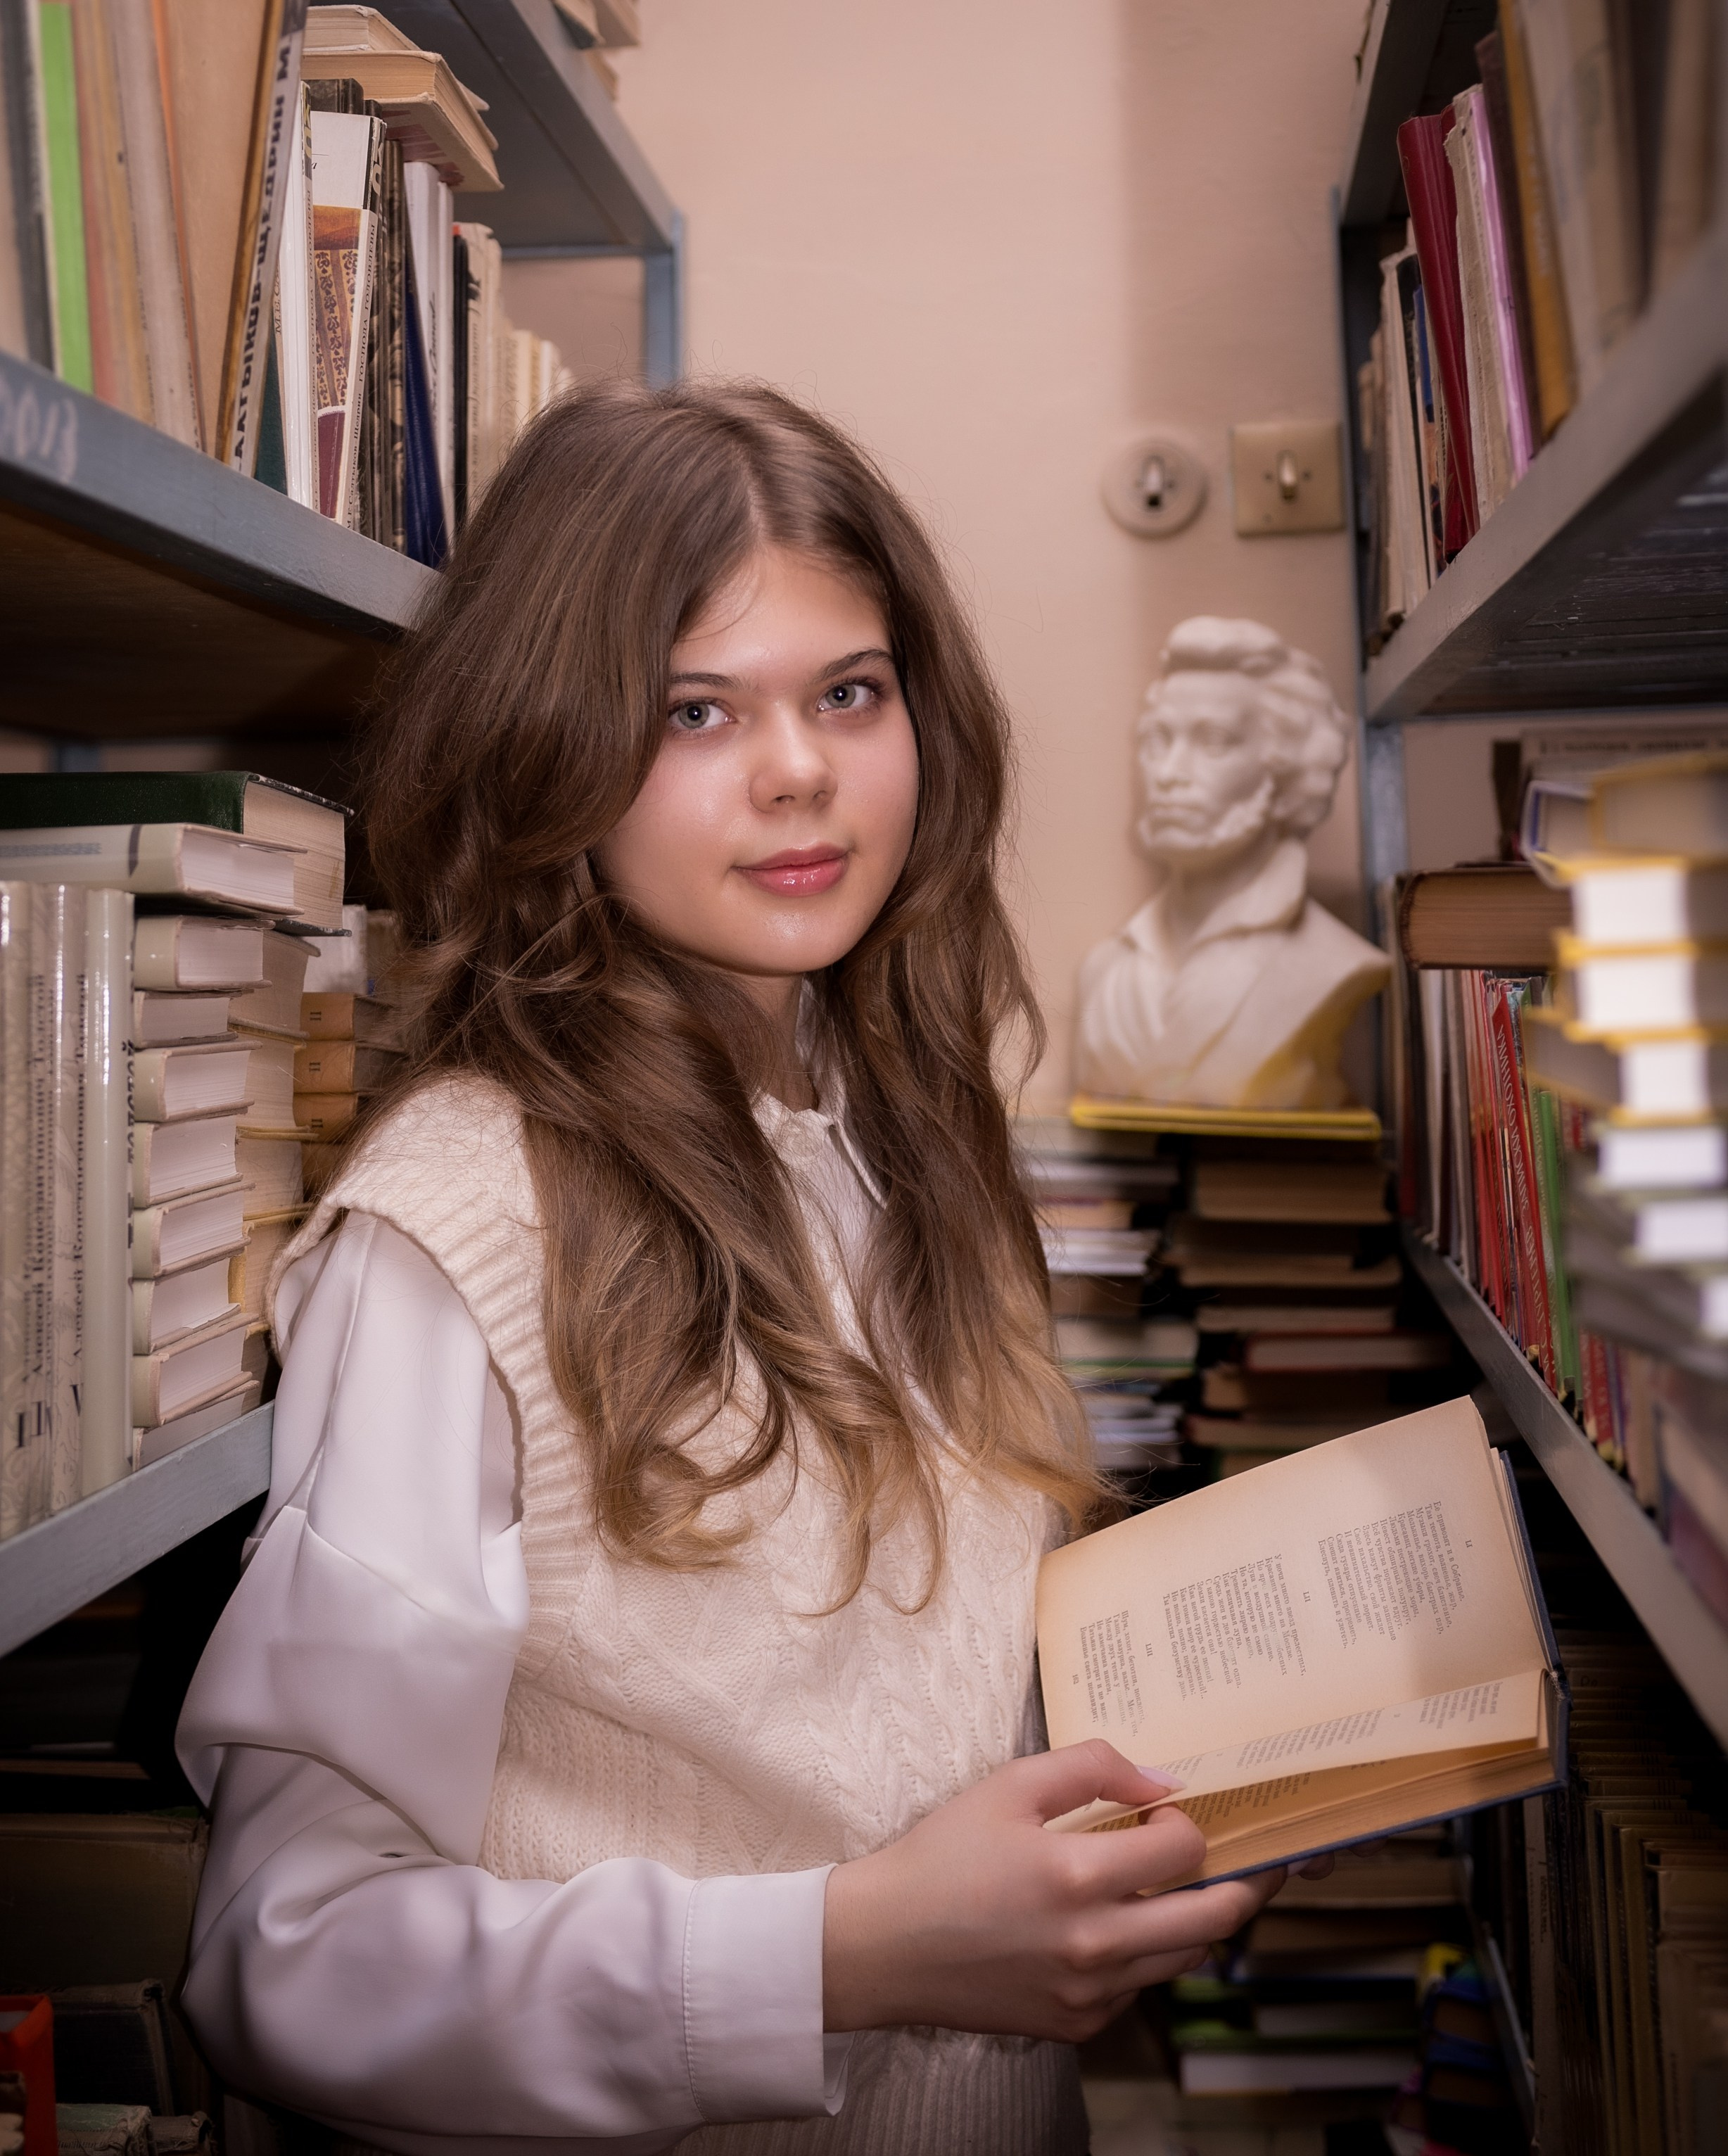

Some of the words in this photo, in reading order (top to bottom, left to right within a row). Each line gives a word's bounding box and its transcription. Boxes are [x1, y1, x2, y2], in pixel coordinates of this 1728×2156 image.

[235, 94, 284, 471] АЛТЫКОВ-ЩЕДРИН
[359, 319, 368, 382] ГОСПОДА
[364, 224, 375, 310] ГОЛОВЛЕВЫ
[1497, 1024, 1516, 1127] ОХОТНИКА
[1511, 1126, 1530, 1212] ЗАПИСКИ
[1525, 1225, 1544, 1324] ТУРГЕНЕВ
[1423, 1503, 1435, 1520] Там
[1432, 1500, 1442, 1512] Ее
[1344, 1529, 1353, 1538] И
[1360, 1523, 1374, 1547] Здесь
[1370, 1521, 1381, 1537] Всё
[1379, 1518, 1393, 1545] Невест
[1395, 1511, 1413, 1549] Красавиц
[1404, 1509, 1425, 1553] Мельканье,
[1413, 1506, 1430, 1538] Музыки
[1434, 1513, 1451, 1548] привозят
[1333, 1532, 1347, 1554] Сюда
[1352, 1526, 1364, 1546] Свое
[1426, 1521, 1442, 1553] теснота,
[1271, 1553, 1282, 1562] У
[1326, 1535, 1340, 1565] Спешат
[1366, 1547, 1379, 1573] кажут
[1373, 1537, 1387, 1567] чувства
[1406, 1549, 1419, 1575] легкие
[1421, 1538, 1437, 1566] грохот,
[1238, 1565, 1248, 1578] Но
[1263, 1556, 1280, 1593] Красавиц
[1275, 1562, 1285, 1580] ночи
[1338, 1554, 1352, 1582] гусары
[1346, 1538, 1368, 1602] невнимательный
[1356, 1546, 1374, 1591] нахальство,
[1385, 1545, 1404, 1586] обширный
[1386, 1514, 1404, 1547] Людьми
[1395, 1547, 1414, 1594] пестреющие
[1406, 1594, 1421, 1618] хоры,
[1416, 1552, 1430, 1580] вихорь
[1430, 1566, 1442, 1585] свеч
[1435, 1552, 1453, 1591] волненье,
[1187, 1583, 1197, 1599] Как
[1195, 1580, 1207, 1604] Земли
[1205, 1577, 1213, 1585] С
[1211, 1574, 1224, 1598] Средь
[1221, 1571, 1231, 1587] Как
[1228, 1568, 1245, 1609] Тревожить
[1240, 1578, 1249, 1590] та,
[1255, 1559, 1265, 1571] Но
[1263, 1592, 1272, 1609] всех
[1331, 1566, 1347, 1599] явиться,
[1372, 1572, 1389, 1604] франты
[1380, 1568, 1397, 1604] поражает
[1411, 1575, 1428, 1604] уборы,
[1447, 1563, 1468, 1603] Собранье.
[1162, 1592, 1171, 1606] Ты
[1170, 1590, 1179, 1602] Но
[1179, 1587, 1188, 1603] Как
[1206, 1585, 1216, 1609] какою
[1217, 1597, 1226, 1613] жен
[1242, 1590, 1256, 1623] которую
[1273, 1593, 1283, 1617] много
[1279, 1582, 1290, 1605] много
[1316, 1538, 1333, 1577] Блеснуть,
[1326, 1577, 1340, 1609] пленить
[1334, 1617, 1349, 1650] улететь.
[1345, 1582, 1363, 1624] отпускные
[1368, 1590, 1380, 1609] свой
[1395, 1587, 1412, 1625] полукруг,
[1423, 1580, 1442, 1616] быстрых
[1434, 1584, 1455, 1629] блистанье,
[1445, 1590, 1459, 1611] жар,
[1119, 1609, 1131, 1631] Шум,
[1171, 1602, 1183, 1628] полно,
[1181, 1603, 1191, 1625] томен
[1190, 1599, 1202, 1621] негой
[1224, 1588, 1238, 1626] величавая
[1245, 1561, 1259, 1583] Луна
[1252, 1590, 1269, 1632] воздушной
[1262, 1632, 1274, 1662] синеве.
[1283, 1606, 1295, 1628] звезд
[1360, 1602, 1374, 1632] лорнет.
[1390, 1605, 1404, 1630] вдруг.
[1095, 1619, 1104, 1630] Не
[1103, 1616, 1114, 1642] Между
[1111, 1613, 1123, 1637] Галоп,
[1164, 1606, 1176, 1639] заплатил
[1193, 1622, 1205, 1645] грудь
[1200, 1604, 1212, 1637] касается
[1209, 1609, 1224, 1649] гордостью
[1221, 1621, 1231, 1636] дев
[1237, 1609, 1250, 1635] лирою
[1250, 1623, 1259, 1634] не
[1278, 1618, 1286, 1628] на
[1340, 1599, 1358, 1646] прогреметь,
[1373, 1610, 1385, 1636] жилет
[1381, 1604, 1397, 1642] записные
[1432, 1616, 1445, 1635] пар,
[1079, 1625, 1091, 1659] Волненье
[1087, 1622, 1098, 1651] Татьяна
[1123, 1631, 1133, 1654] хохот,
[1176, 1628, 1188, 1654] полно;
[1185, 1626, 1195, 1644] взор
[1207, 1637, 1217, 1656] она!
[1231, 1627, 1243, 1649] луна,
[1243, 1635, 1254, 1659] моею,
[1253, 1635, 1264, 1656] смею
[1281, 1629, 1295, 1661] Москве.
[1097, 1631, 1108, 1668] замечаема
[1107, 1642, 1116, 1660] двух
[1114, 1637, 1126, 1670] мазурка,
[1169, 1640, 1185, 1680] безумству
[1190, 1644, 1197, 1654] ее
[1199, 1645, 1207, 1656] ее
[1288, 1628, 1307, 1677] прелестных,
[1084, 1659, 1093, 1680] света
[1091, 1652, 1102, 1682] смотрит
[1111, 1660, 1119, 1681] теток
[1126, 1654, 1141, 1687] беготня,
[1201, 1656, 1214, 1683] полна!
[1219, 1649, 1233, 1685] небесной
[1230, 1667, 1242, 1689] одна.
[1102, 1669, 1112, 1695] никем,
[1086, 1681, 1099, 1723] ненавидит;
[1098, 1690, 1105, 1701] не
[1126, 1699, 1136, 1718] Меж
[1128, 1720, 1138, 1738] тем,
